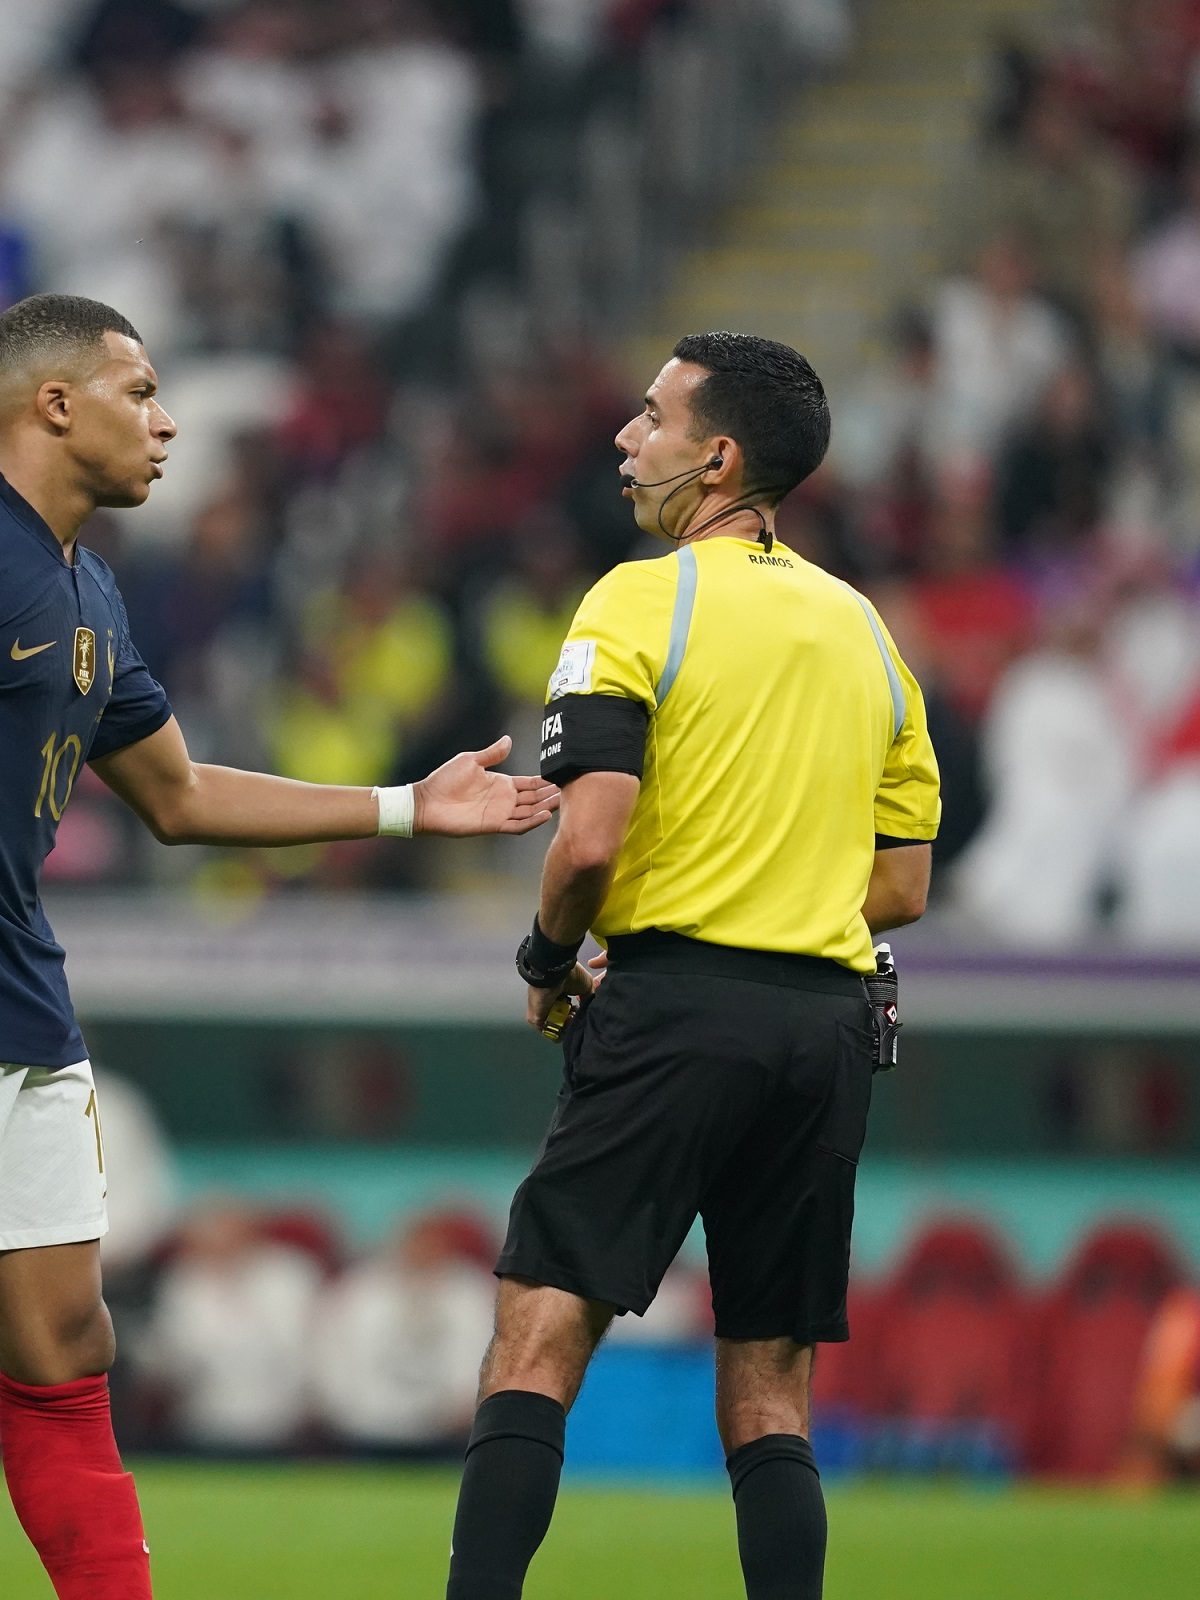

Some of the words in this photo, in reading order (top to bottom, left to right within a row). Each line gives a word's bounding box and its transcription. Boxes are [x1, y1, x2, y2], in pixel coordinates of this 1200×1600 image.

[748, 554, 794, 569] RAMOS
[541, 712, 563, 744] IFA
[547, 741, 562, 757] ONE
[34, 730, 81, 822] 10
